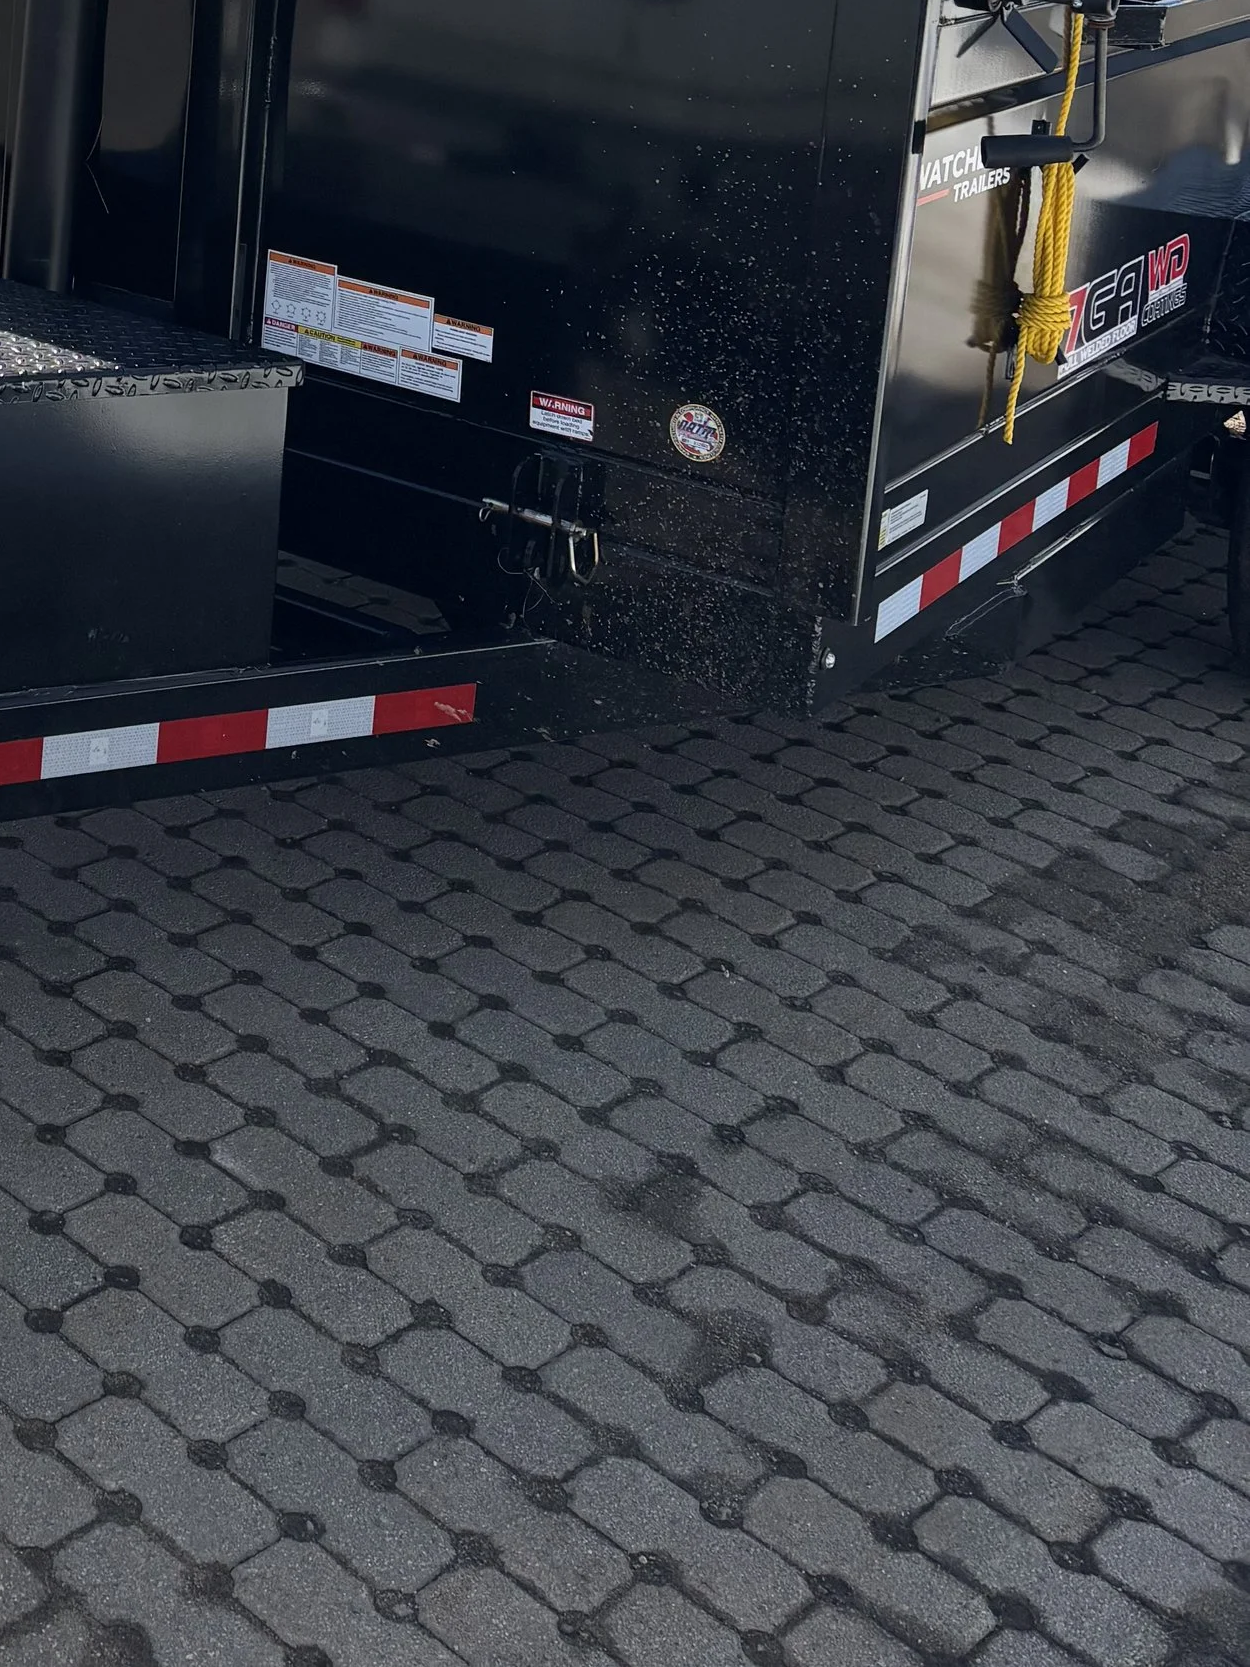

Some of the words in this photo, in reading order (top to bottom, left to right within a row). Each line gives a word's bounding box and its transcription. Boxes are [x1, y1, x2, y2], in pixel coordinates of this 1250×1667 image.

[953, 166, 1011, 203] TRAILERS
[271, 319, 296, 331] DANGER
[451, 319, 481, 332] WARNING
[1111, 320, 1136, 346] FLOOR
[366, 344, 397, 357] WARNING
[417, 354, 447, 367] WARNING
[539, 397, 586, 415] WARNING
